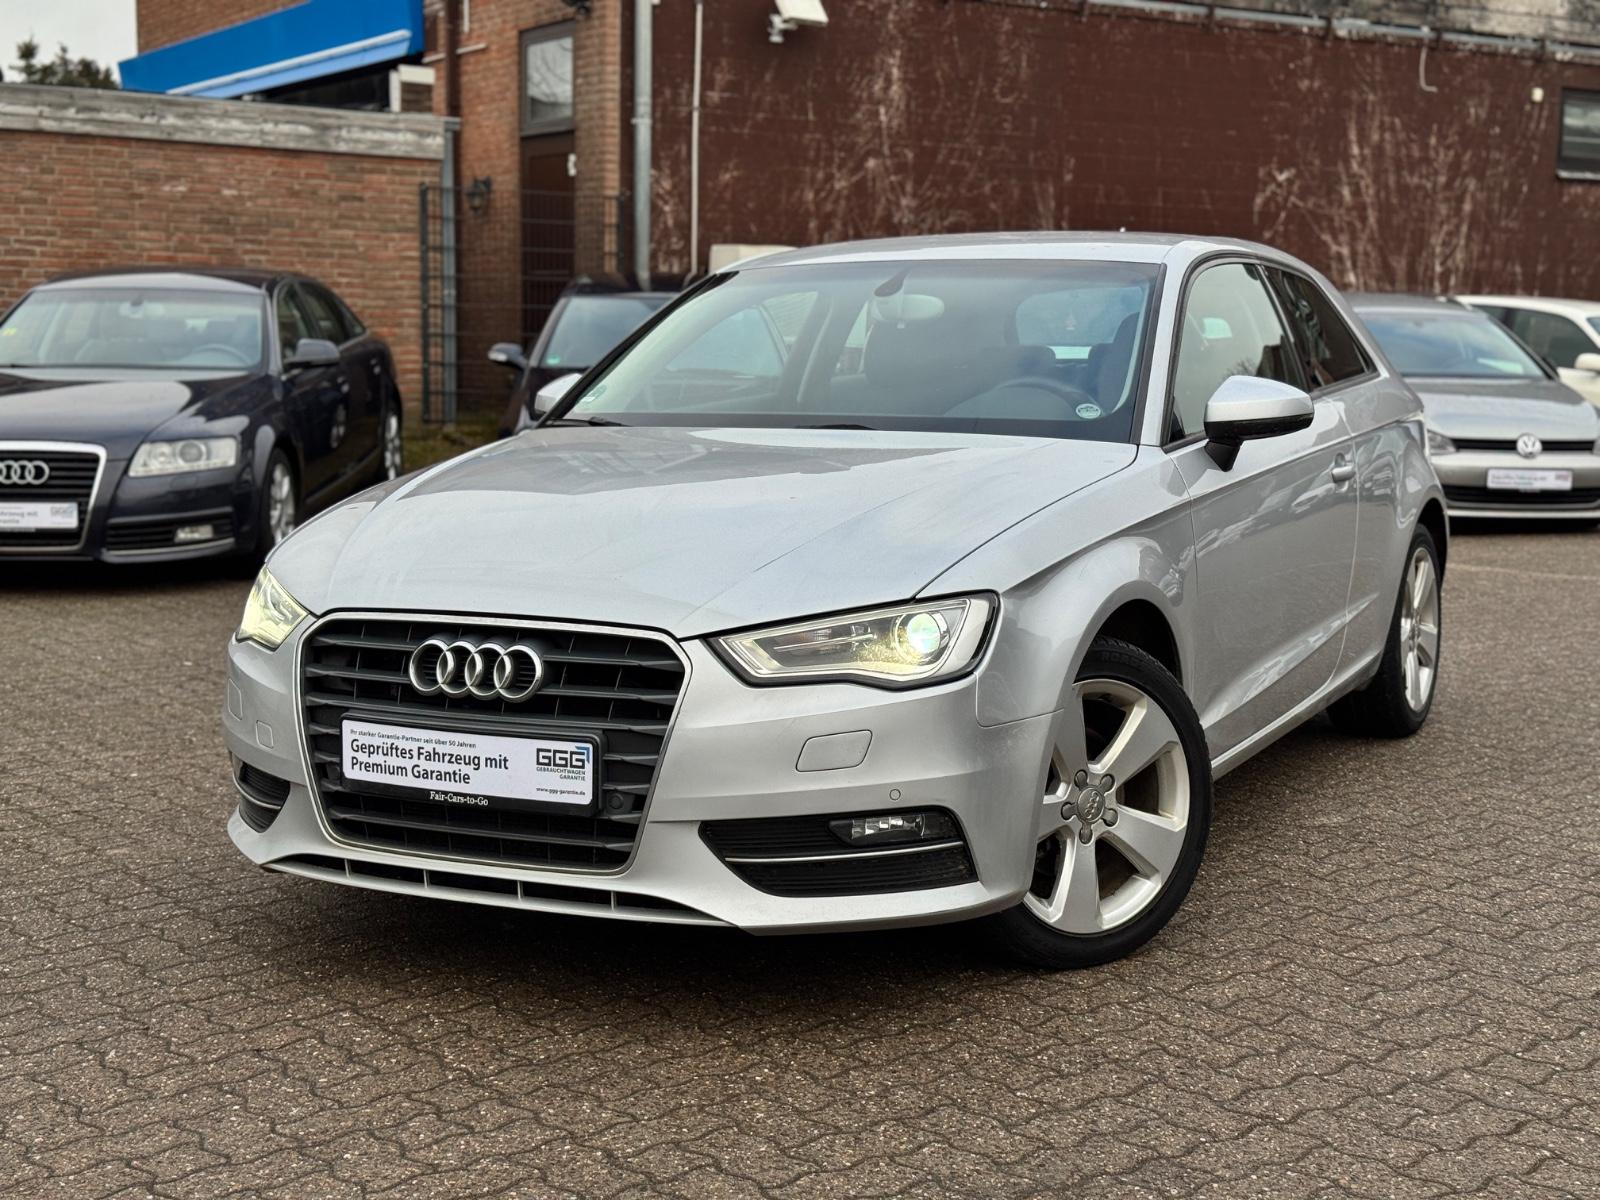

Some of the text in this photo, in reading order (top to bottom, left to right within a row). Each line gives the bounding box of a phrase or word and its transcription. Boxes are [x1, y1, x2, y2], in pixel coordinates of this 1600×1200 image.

[358, 730, 377, 738] starker
[377, 732, 423, 743] Garantie-Partner
[456, 740, 477, 749] Jahren
[350, 738, 509, 771] Geprüftes Fahrzeug mit
[536, 747, 586, 770] GGG
[351, 756, 471, 784] Premium Garantie
[536, 766, 586, 776] GEBRAUCHTWAGEN
[559, 774, 586, 782] GARANTIE
[429, 791, 489, 806] Fair-Cars-to-Go
